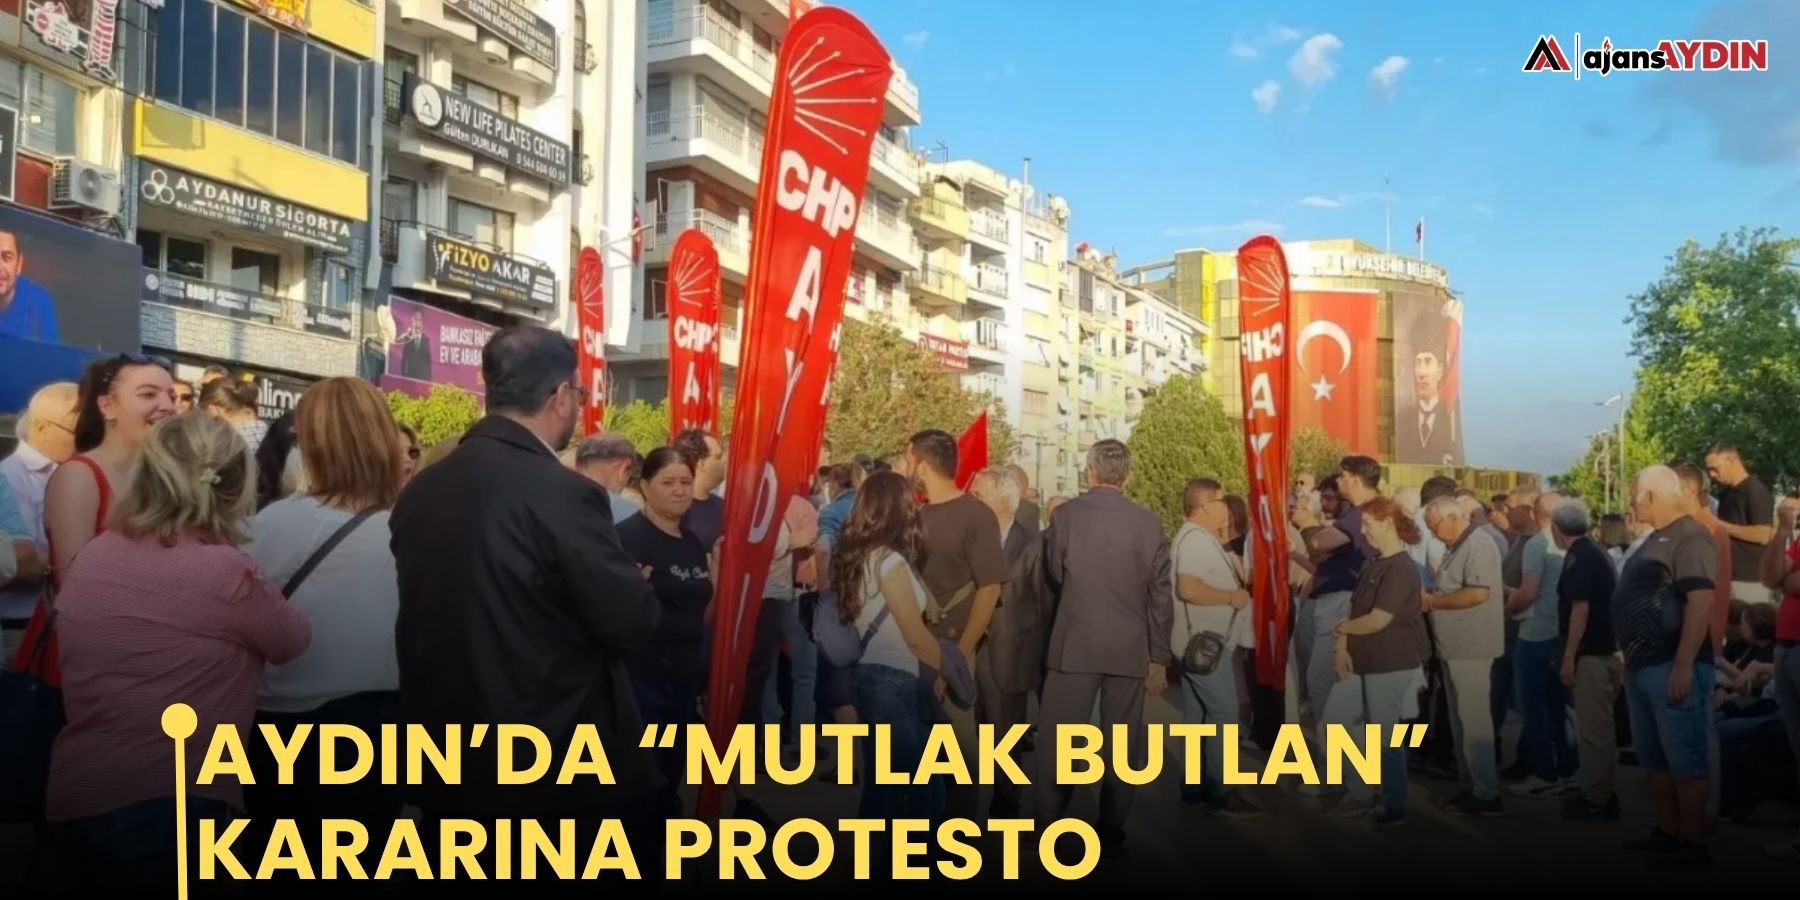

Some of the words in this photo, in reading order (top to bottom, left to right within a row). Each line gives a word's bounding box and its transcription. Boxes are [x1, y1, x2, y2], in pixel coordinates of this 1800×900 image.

[445, 95, 472, 126] NEW
[473, 108, 494, 134] LIFE
[495, 117, 532, 152] PILATES
[533, 135, 566, 165] CENTER
[175, 176, 271, 216] AYDANUR
[275, 204, 351, 238] SİGORTA
[776, 148, 857, 239] CHP
[492, 257, 531, 286] AKAR
[674, 315, 713, 353] CHP
